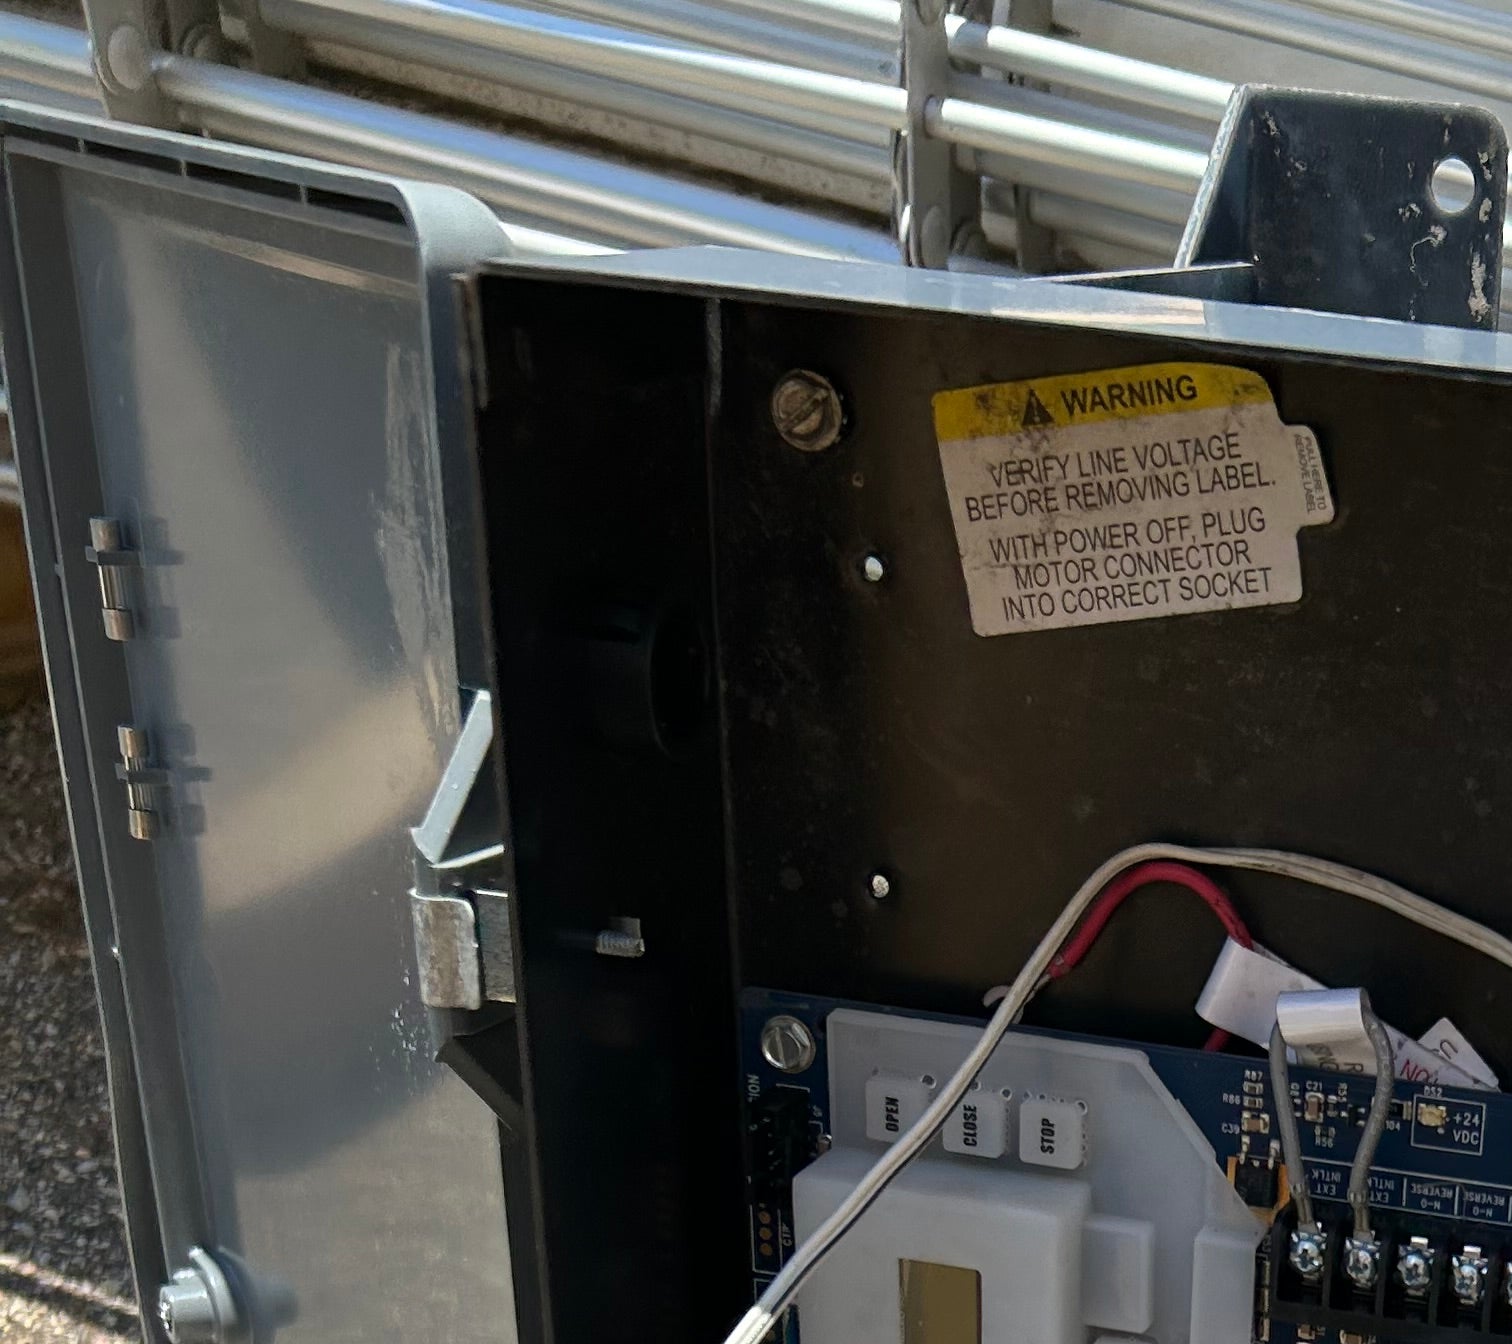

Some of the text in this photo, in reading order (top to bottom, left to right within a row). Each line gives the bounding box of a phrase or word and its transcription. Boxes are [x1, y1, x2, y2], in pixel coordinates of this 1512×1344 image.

[1061, 375, 1198, 416] WARNING
[992, 432, 1242, 488] VERIFY LINE VOLTAGE
[966, 461, 1276, 522] BEFORE REMOVING LABEL.
[1303, 482, 1316, 514] LABEL
[1317, 496, 1327, 510] TO
[989, 506, 1266, 564] WITH POWER OFF, PLUG
[1015, 539, 1251, 590] MOTOR CONNECTOR
[1003, 567, 1272, 622] INTO CORRECT SOCKET
[746, 1073, 760, 1103] ION
[885, 1096, 899, 1132] OPEN
[963, 1104, 977, 1147] CLOSE
[1453, 1115, 1480, 1128] +24
[1040, 1117, 1055, 1154] STOP
[1453, 1132, 1479, 1147] VDC
[1311, 1168, 1342, 1182] INTLK
[1315, 1181, 1336, 1195] EXT
[1410, 1182, 1453, 1197] REVERSE
[1464, 1190, 1505, 1206] REVERSE
